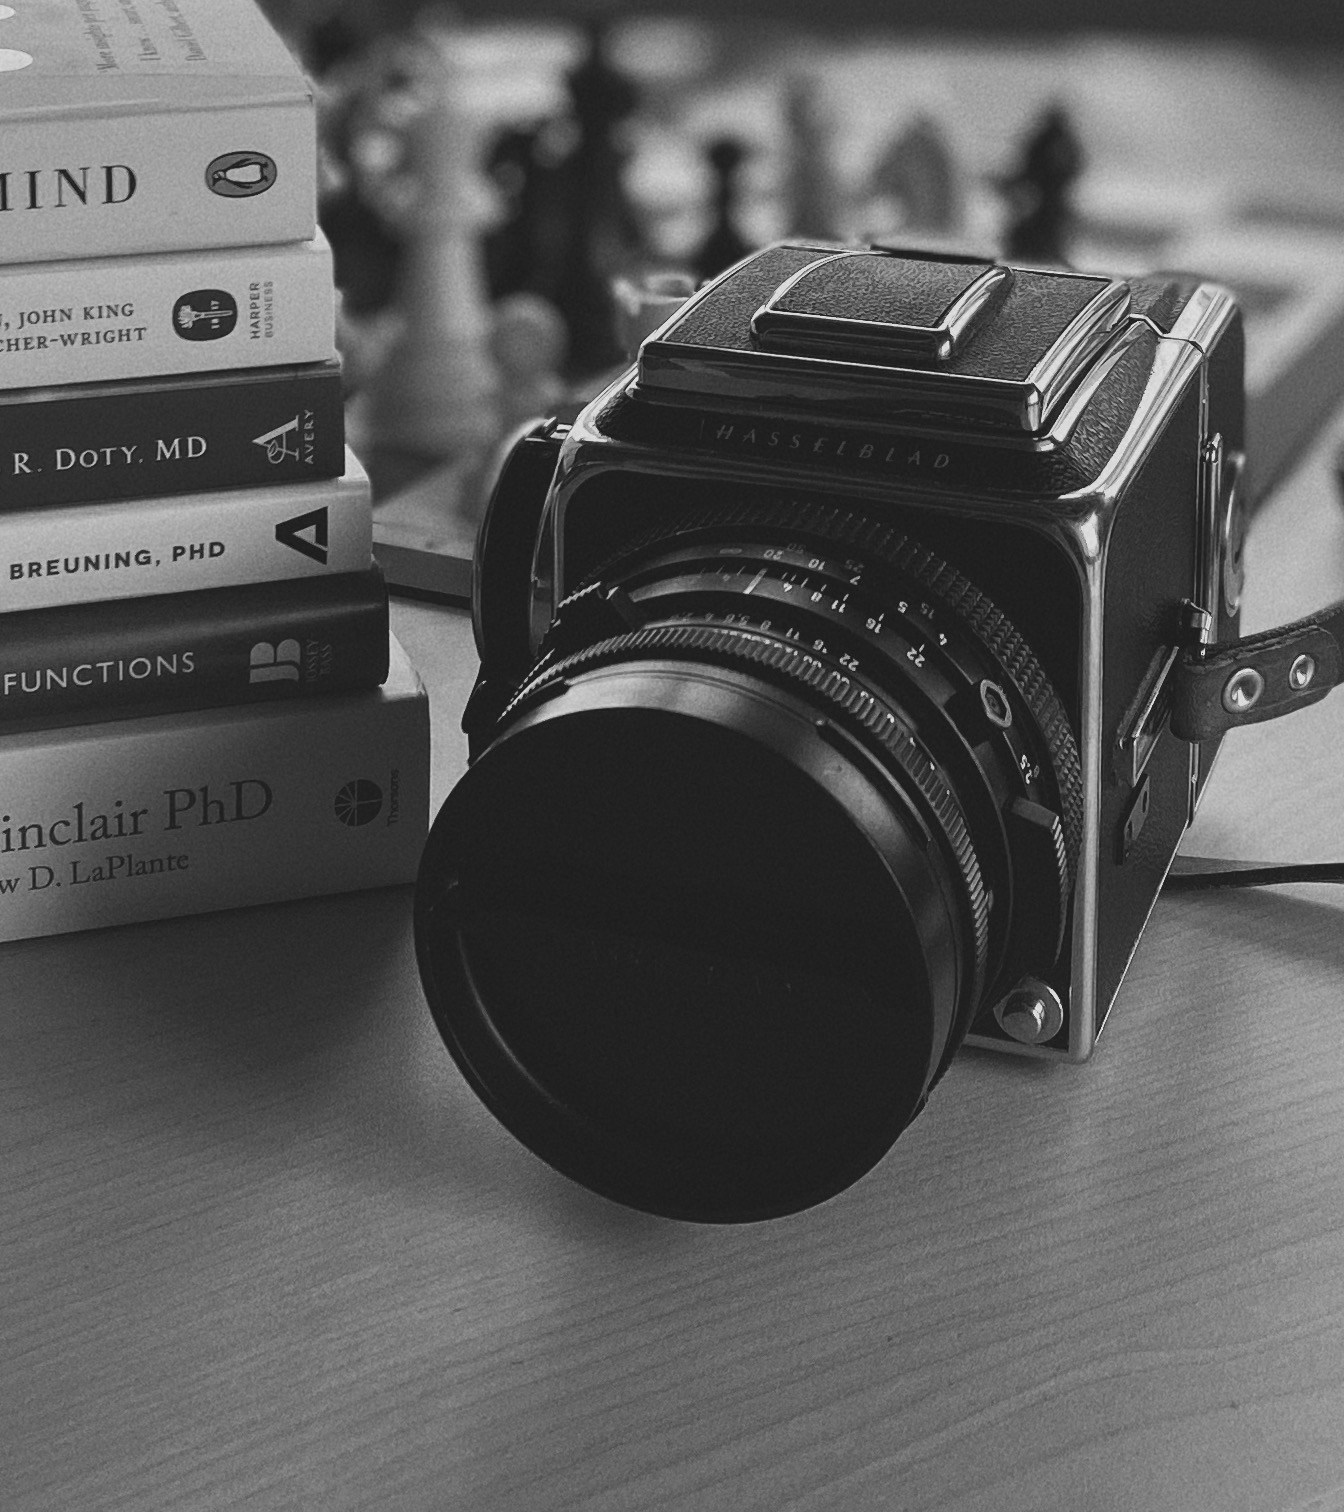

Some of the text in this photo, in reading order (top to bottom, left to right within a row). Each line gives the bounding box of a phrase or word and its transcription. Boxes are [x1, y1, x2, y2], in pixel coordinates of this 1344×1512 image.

[18, 307, 74, 330] JOHN
[83, 301, 135, 323] KING
[249, 282, 261, 339] HARPER
[263, 280, 274, 338] BUSINESS
[12, 451, 43, 474] R.
[155, 435, 208, 461] MD
[303, 408, 315, 465] AVERY
[715, 424, 950, 469] HASSELBLAD
[9, 548, 162, 581] BREUNING,
[171, 540, 227, 564] PHD
[808, 558, 826, 571] 10
[896, 600, 908, 614] 5
[839, 653, 860, 672] 22
[906, 647, 926, 668] 22
[162, 777, 273, 832] PhD
[28, 866, 62, 890] D.
[69, 849, 190, 886] LaPlante
